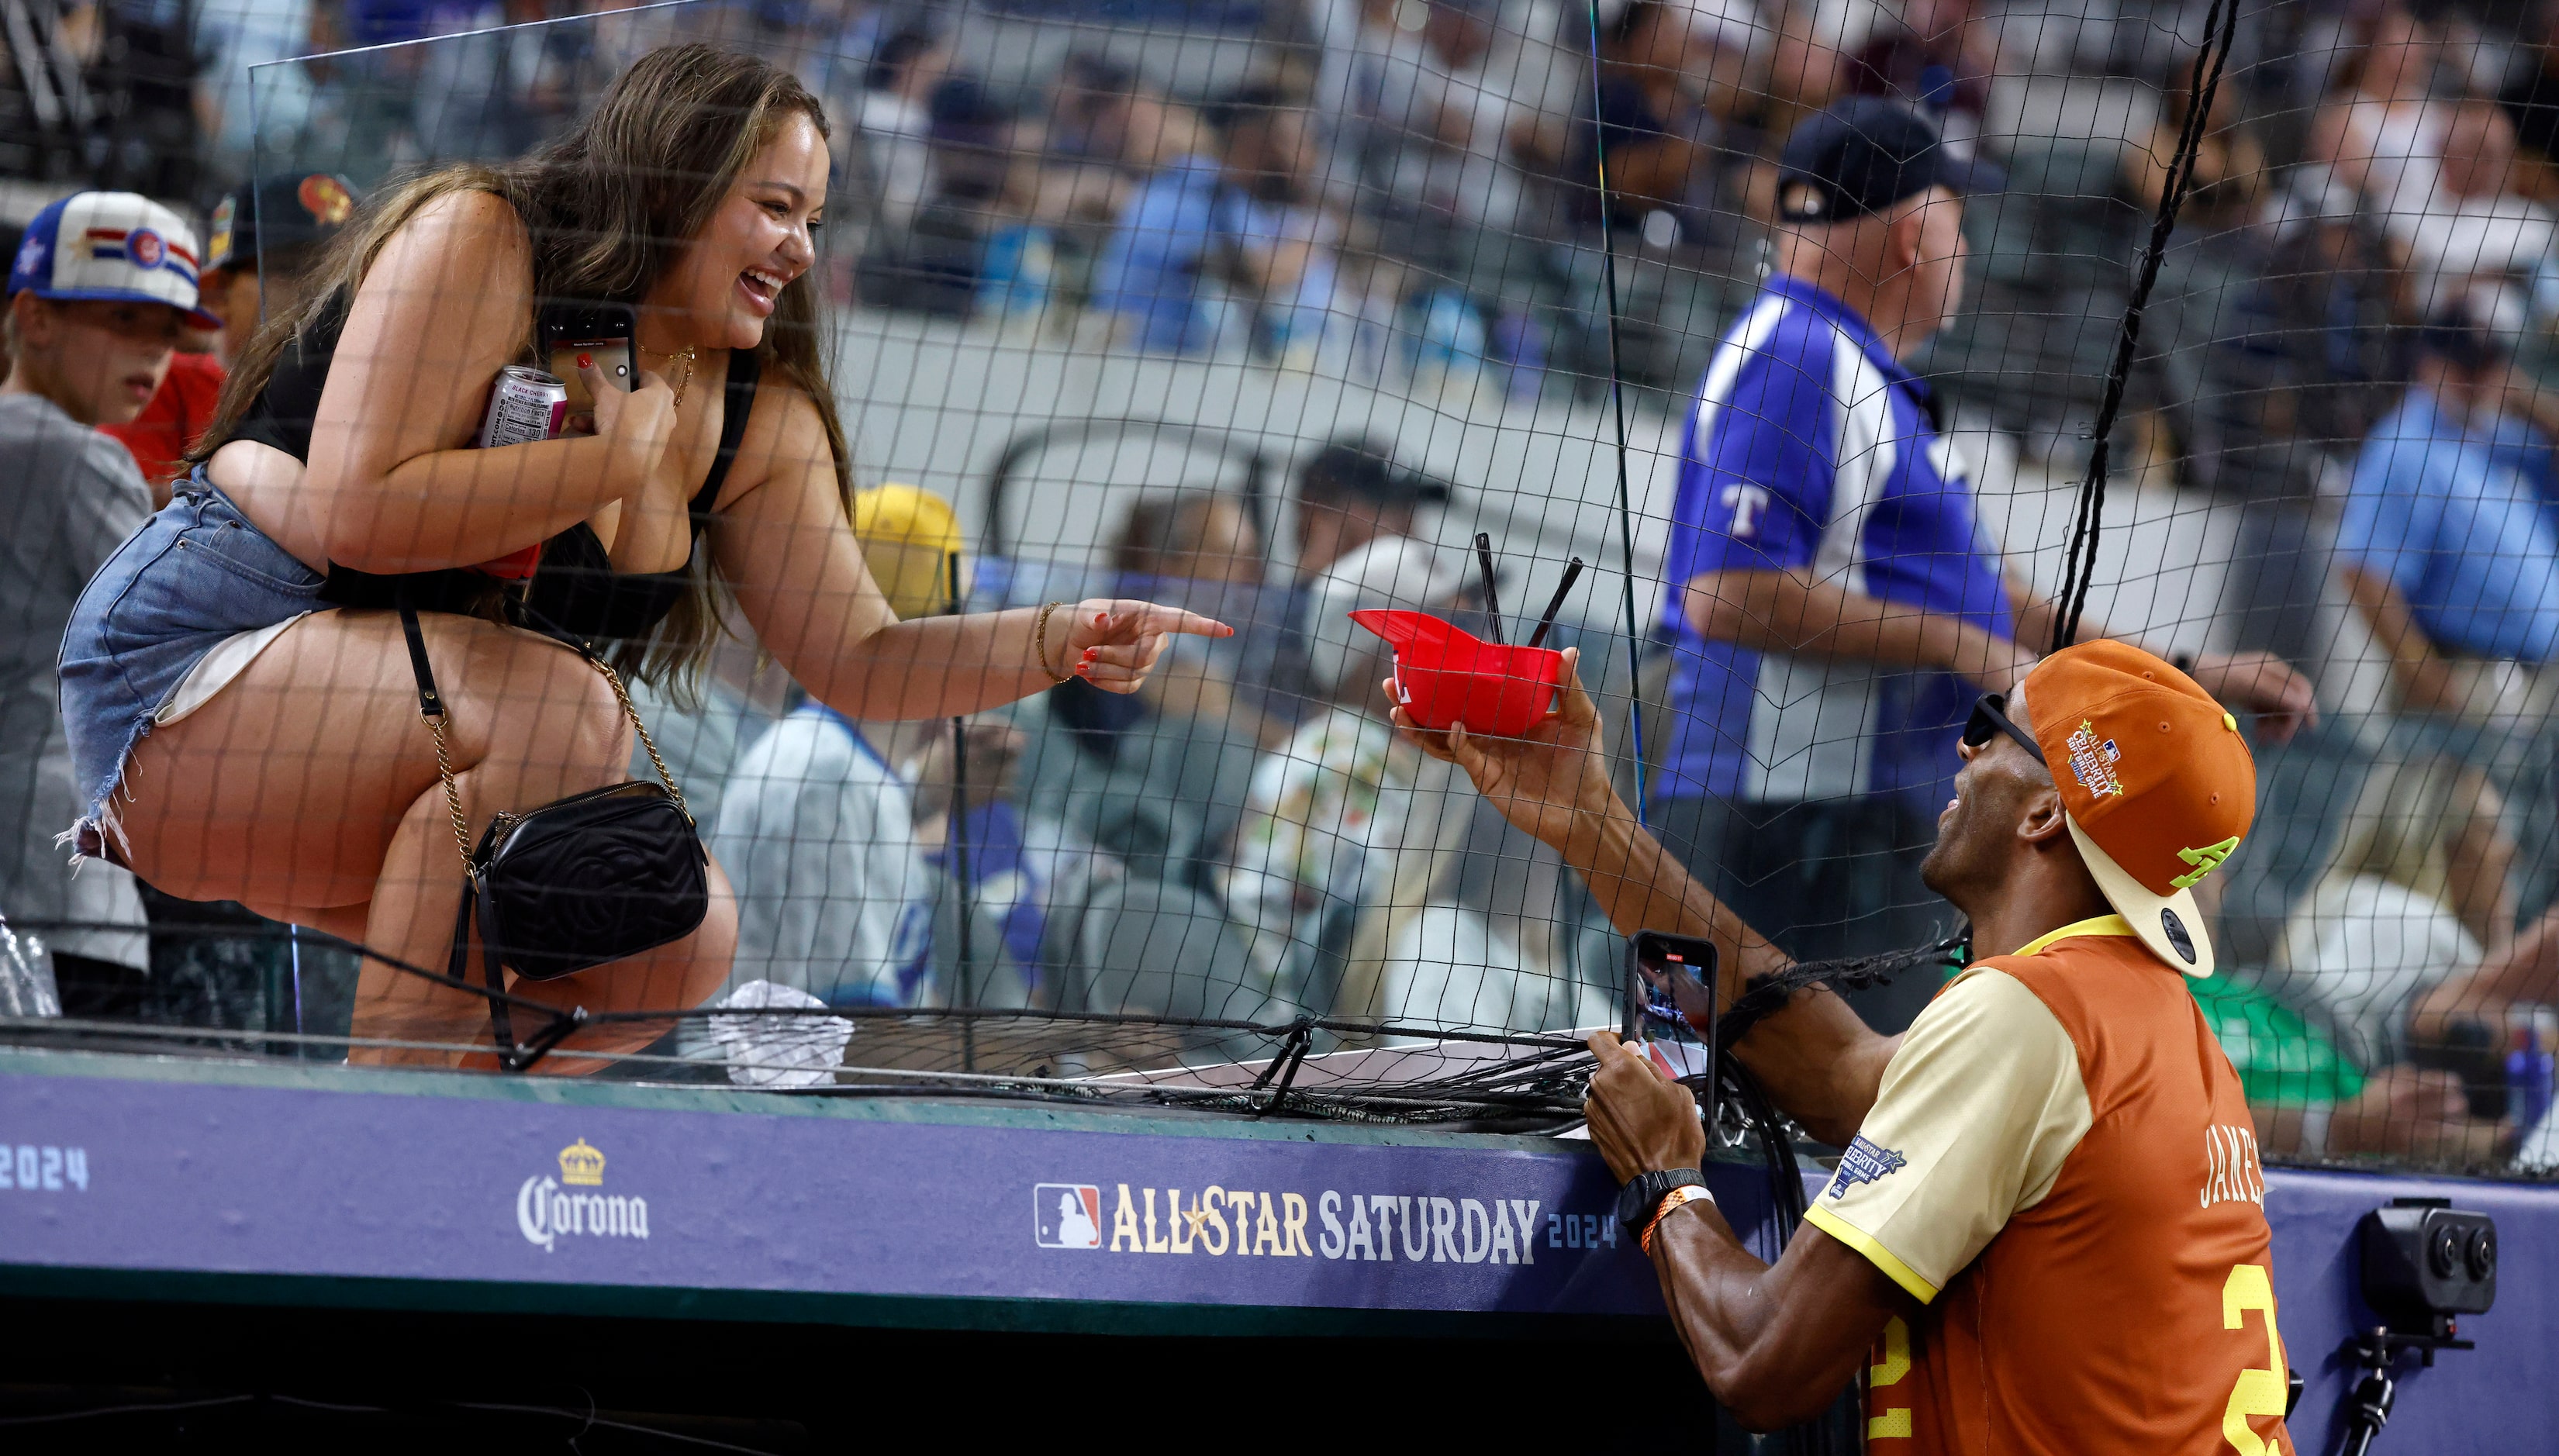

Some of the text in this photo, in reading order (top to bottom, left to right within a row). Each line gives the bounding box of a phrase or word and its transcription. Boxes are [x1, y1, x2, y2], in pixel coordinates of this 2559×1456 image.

[509, 404, 544, 417] Nutrition Facts
[512, 385, 549, 398] BLACK CHERRY
[505, 424, 541, 437] Calories 130
[1720, 484, 1770, 537] T
[2066, 737, 2102, 799] SOFTBALL GAME
[2072, 730, 2114, 794] CELEBRITY
[0, 1144, 88, 1192] 2024
[1853, 1167, 1870, 1181] GAME
[516, 1175, 650, 1253] Corona
[1318, 1189, 1540, 1265] SATURDAY
[1548, 1213, 1617, 1250] 2024
